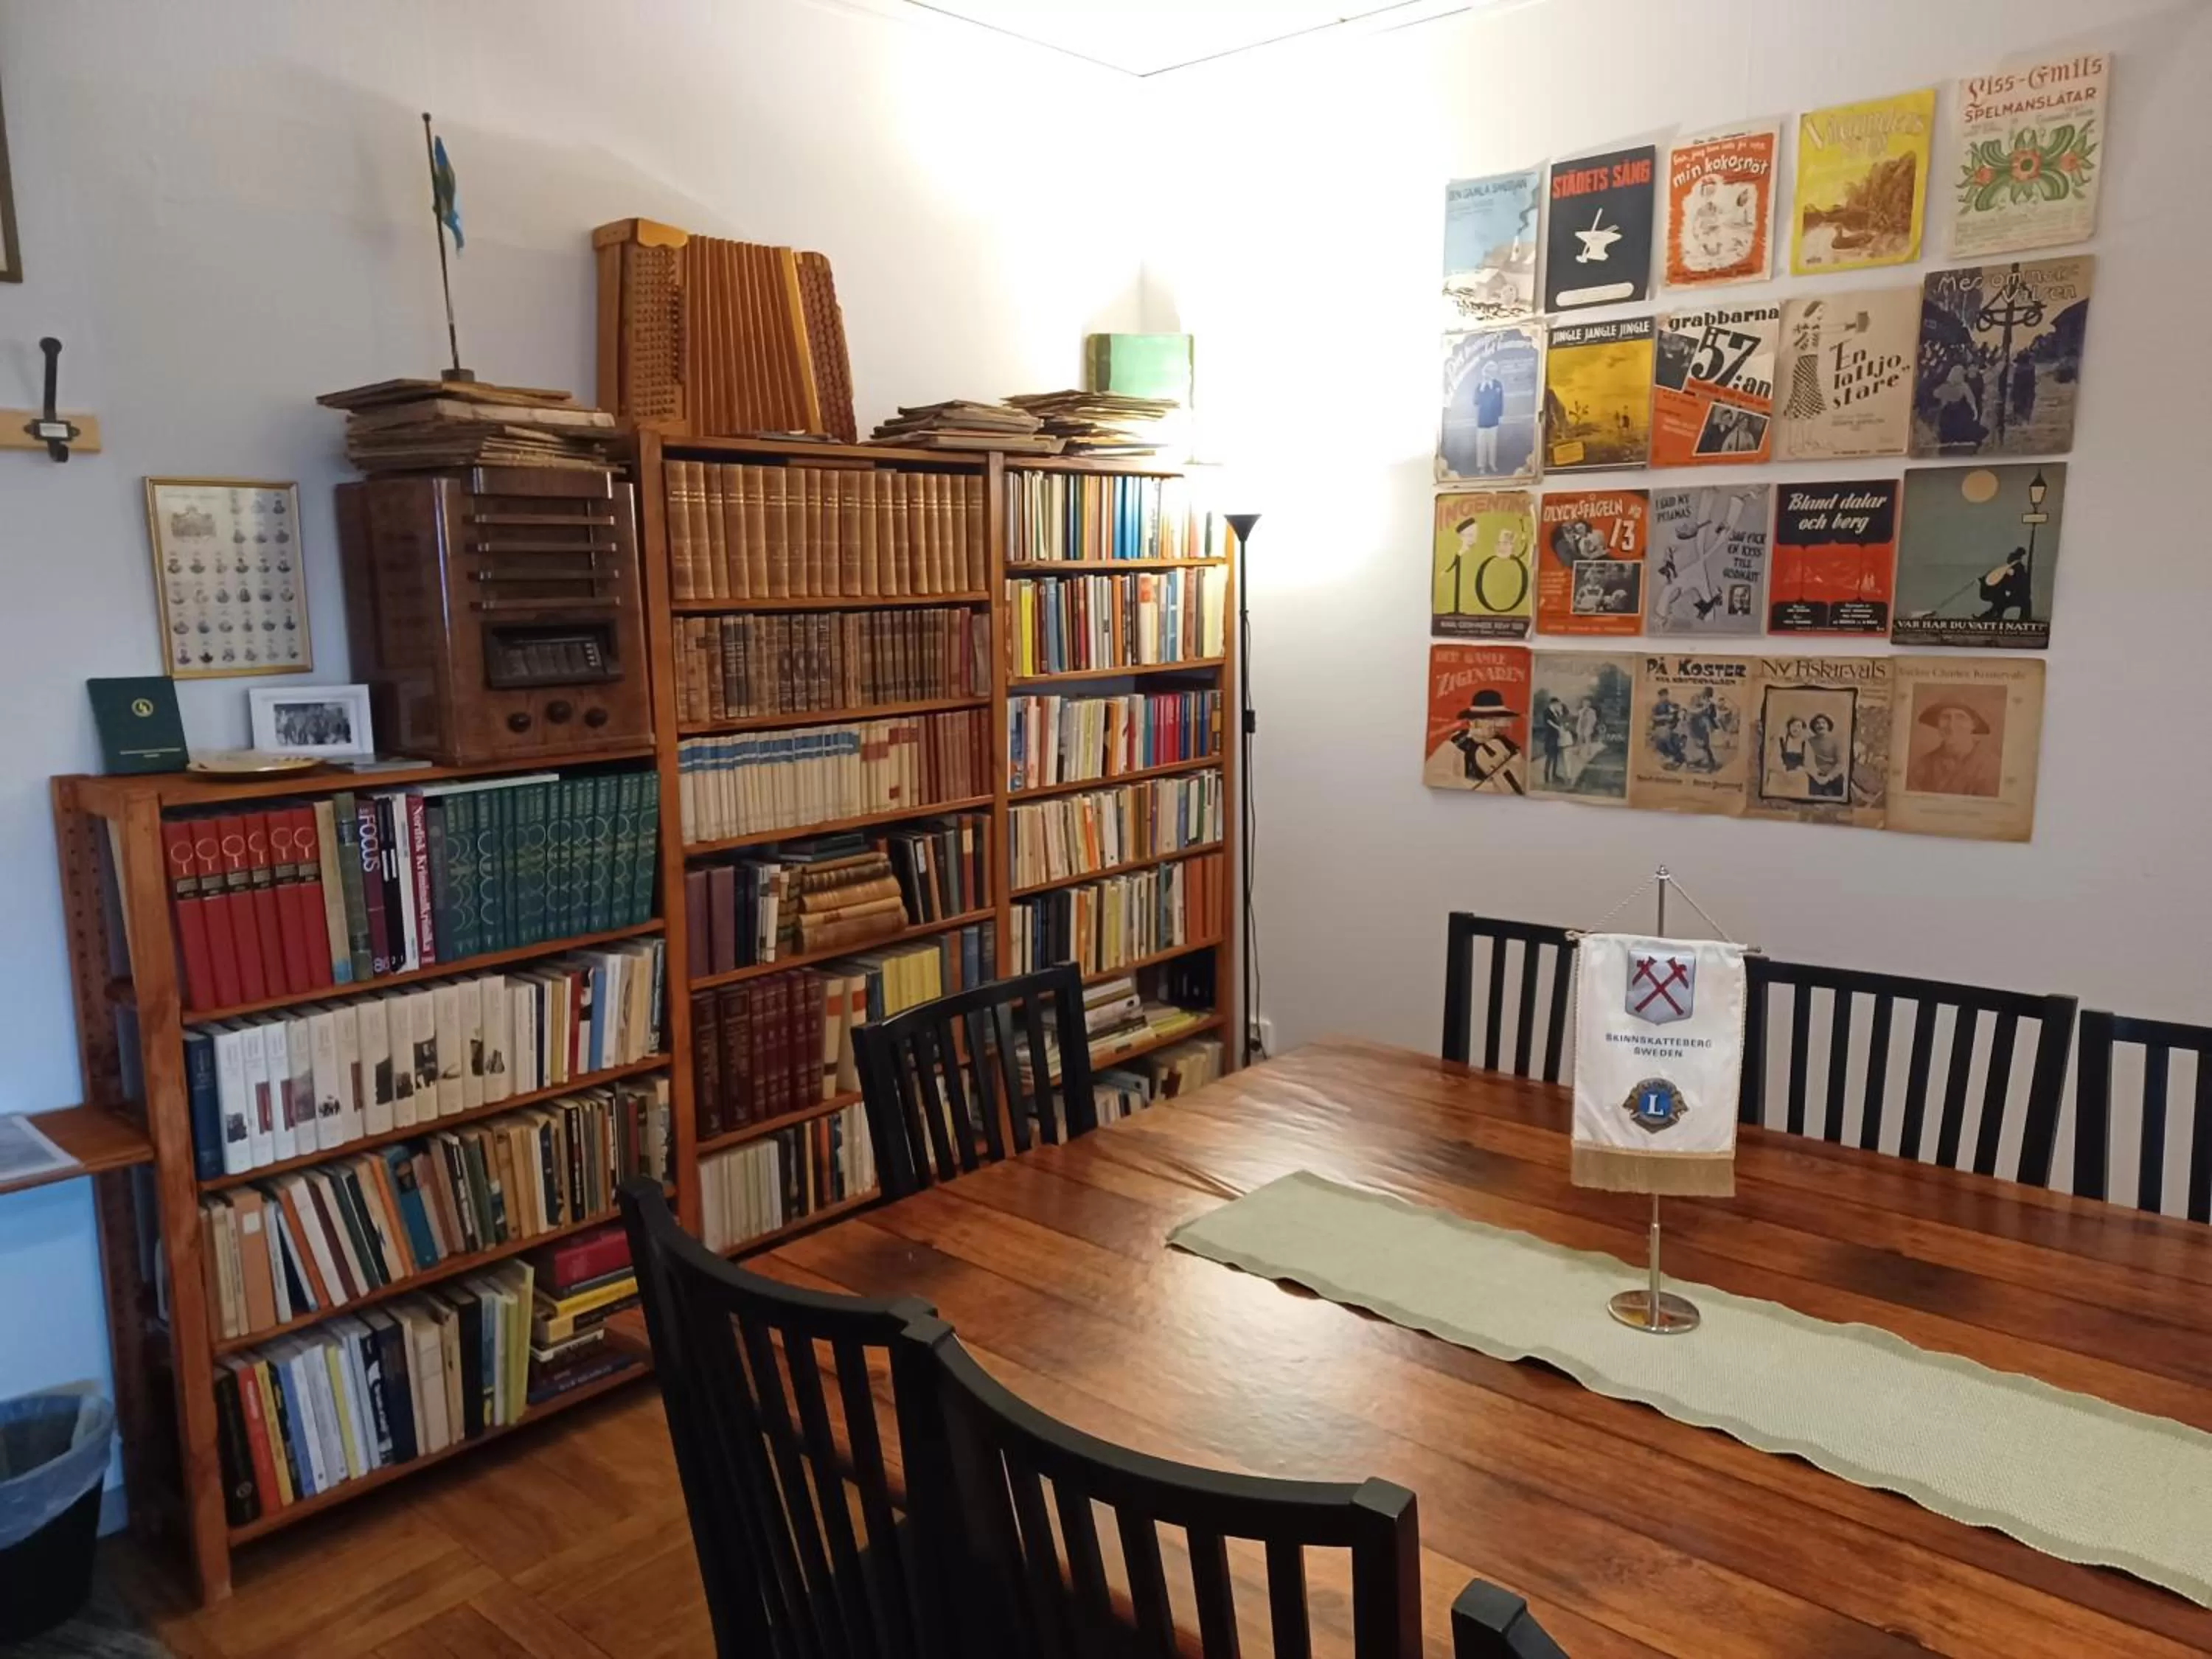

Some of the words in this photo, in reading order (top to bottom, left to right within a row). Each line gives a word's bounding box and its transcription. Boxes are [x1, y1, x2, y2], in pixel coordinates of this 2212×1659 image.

[1673, 163, 1702, 188] min
[1669, 307, 1779, 332] grabbarna
[1552, 329, 1582, 345] JINGLE
[1584, 324, 1617, 343] JANGLE
[1618, 320, 1650, 339] JINGLE
[1787, 493, 1839, 511] Bland
[1840, 493, 1888, 509] dalar
[1609, 518, 1635, 551] 13
[1798, 513, 1828, 530] och
[1832, 512, 1870, 535] berg
[1445, 553, 1529, 613] 10
[1898, 620, 1920, 629] VAR
[1922, 620, 1945, 630] HAR
[1950, 621, 1966, 630] DU
[1646, 656, 1668, 675] PÅ
[1678, 658, 1746, 678] KOSTER
[358, 814, 380, 872] FOCUS
[1606, 1033, 1711, 1048] SKINNSKATTEBERG
[1634, 1047, 1683, 1057] SWEDEN
[1646, 1094, 1664, 1116] L
